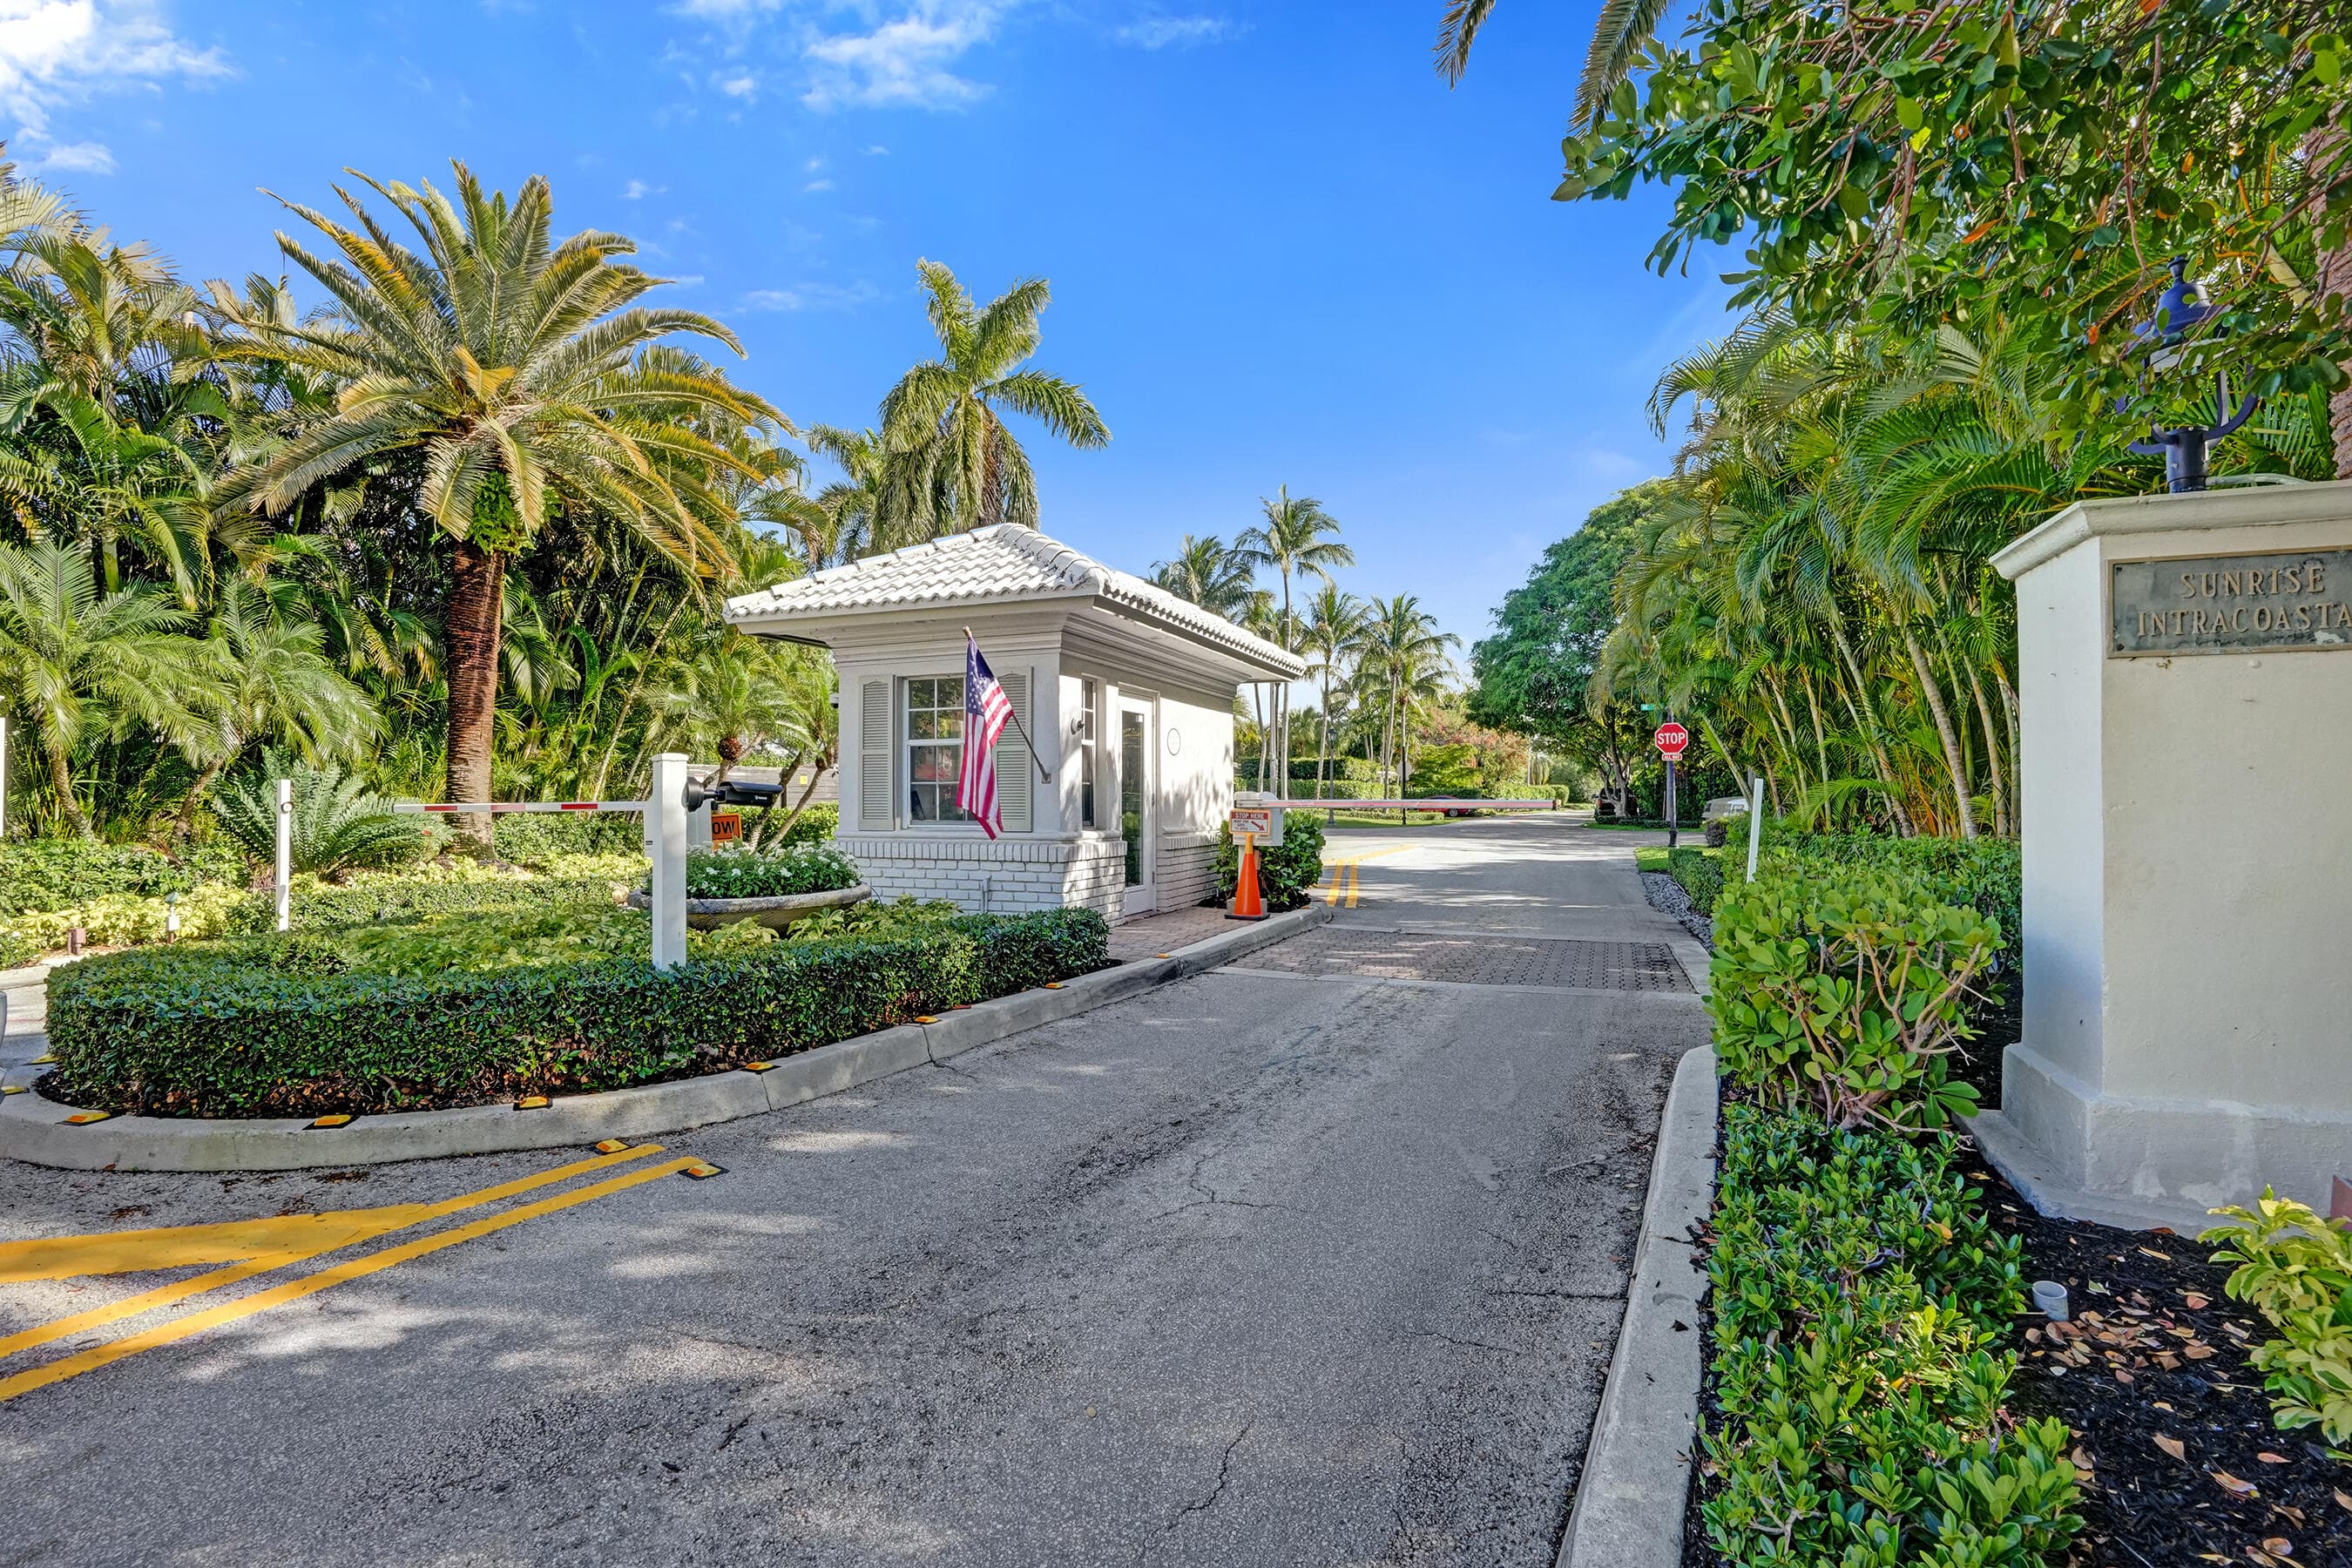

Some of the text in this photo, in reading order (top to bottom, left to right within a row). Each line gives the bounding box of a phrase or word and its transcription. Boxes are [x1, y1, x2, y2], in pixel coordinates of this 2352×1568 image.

[2180, 564, 2326, 599] SUNRISE
[2137, 601, 2352, 638] INTRACOASTA
[1658, 733, 1686, 745] STOP
[712, 821, 735, 835] OW
